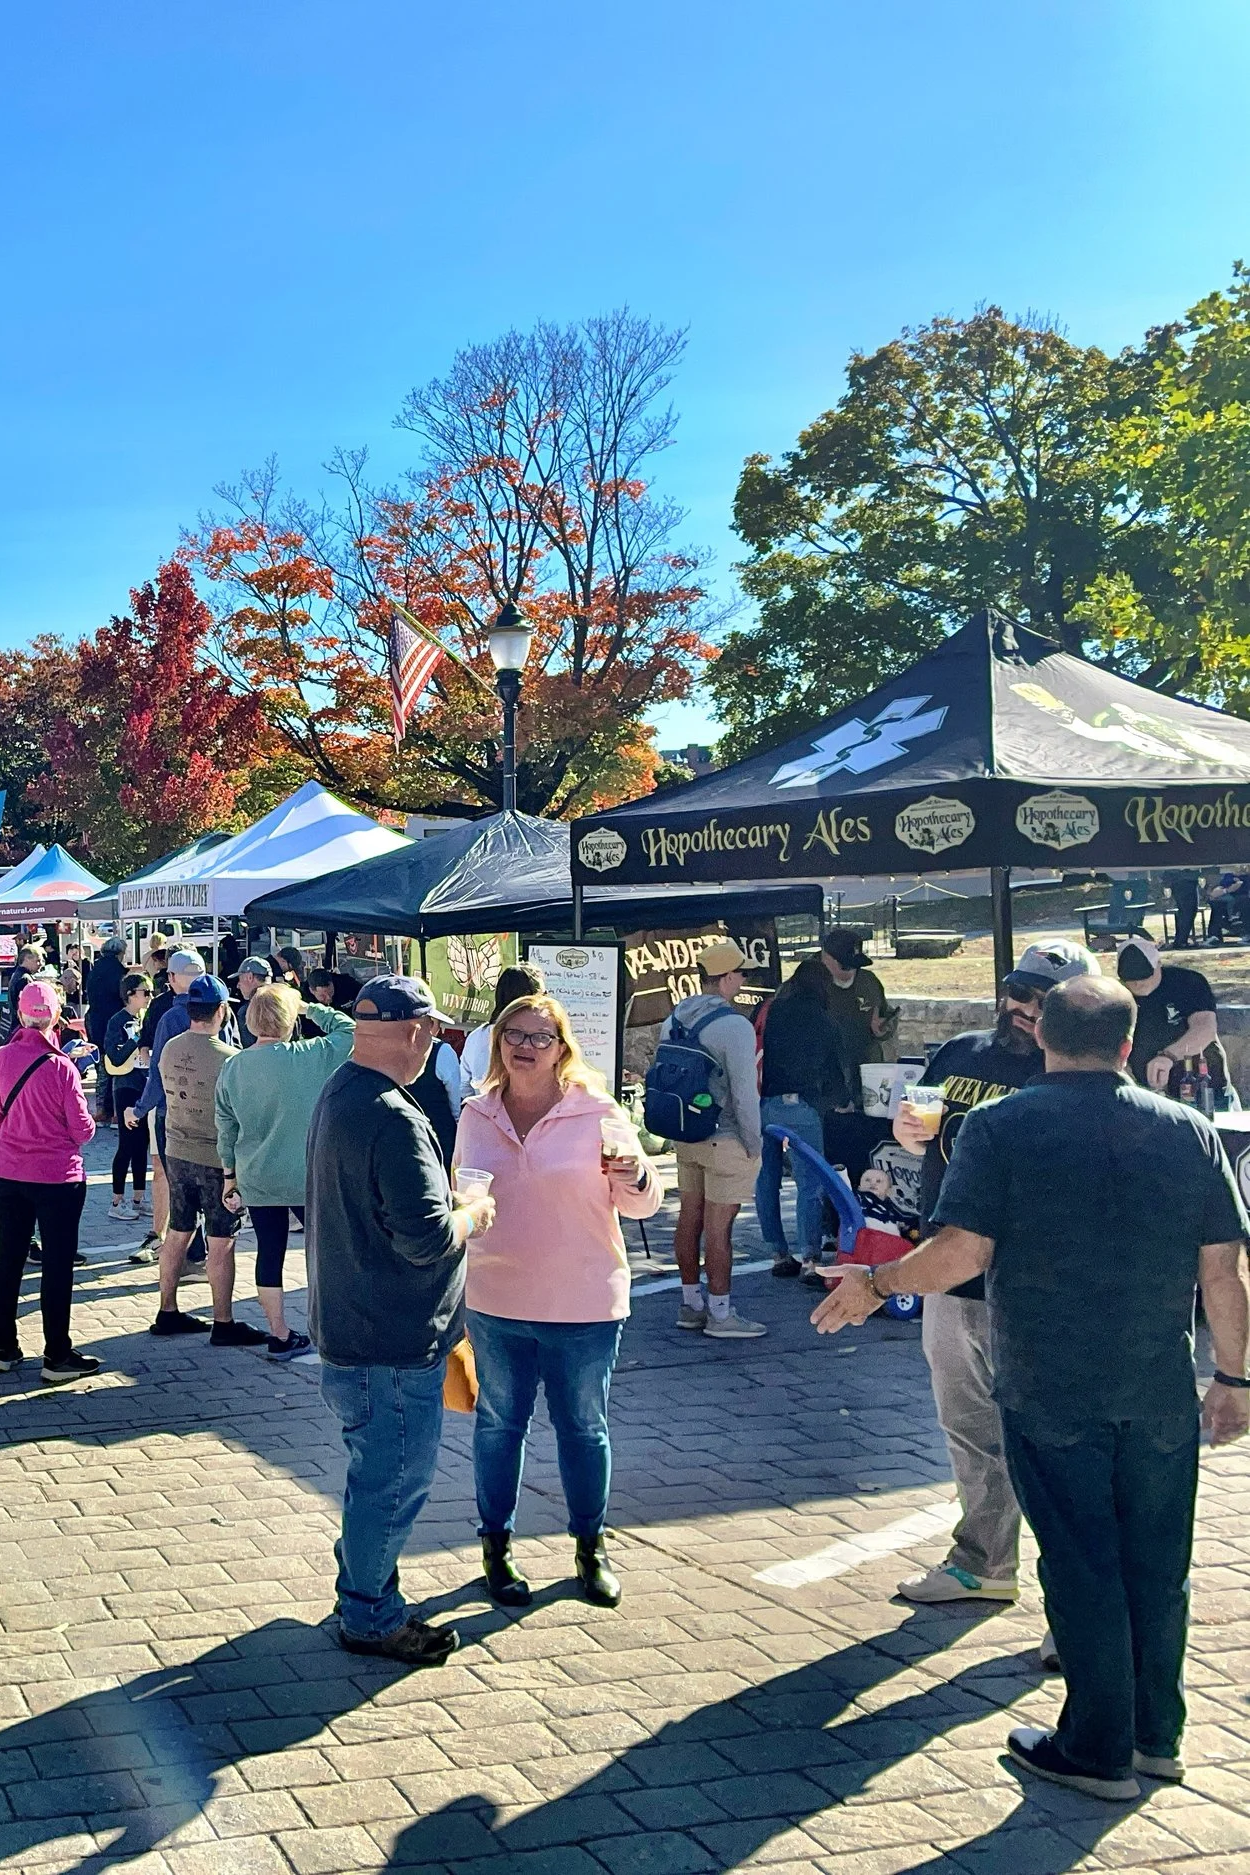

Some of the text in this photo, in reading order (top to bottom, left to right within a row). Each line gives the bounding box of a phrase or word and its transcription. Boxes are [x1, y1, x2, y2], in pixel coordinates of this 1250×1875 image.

[641, 806, 871, 867] Hopothecary Ales
[122, 884, 209, 911] DROP ZONE BREWERY
